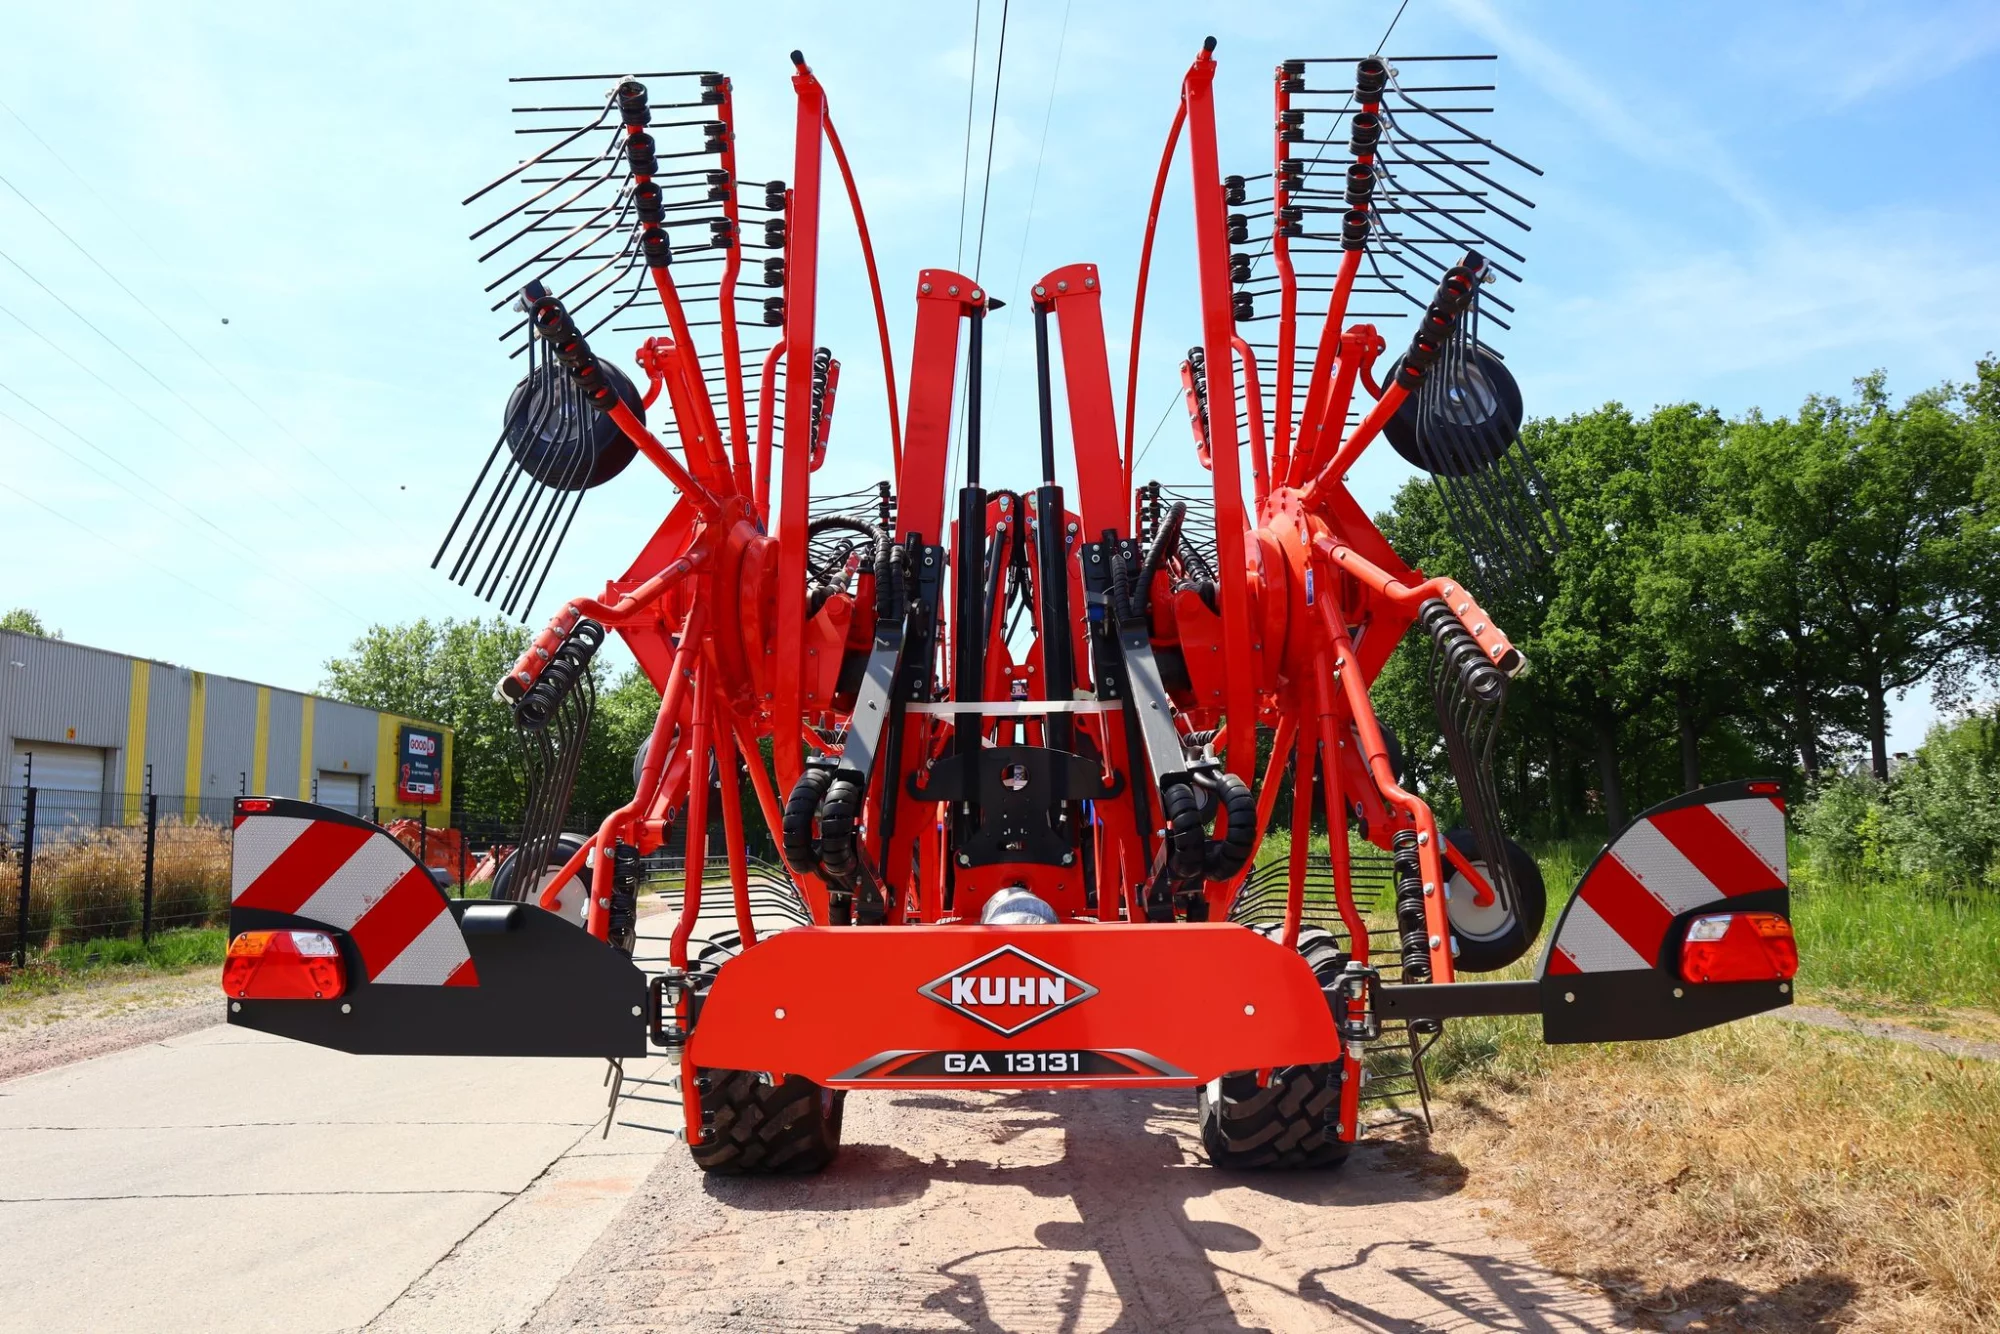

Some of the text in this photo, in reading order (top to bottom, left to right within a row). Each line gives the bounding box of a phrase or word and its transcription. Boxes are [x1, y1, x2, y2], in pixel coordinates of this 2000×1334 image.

[951, 976, 1065, 1005] KUHN
[944, 1053, 1079, 1072] GA 13131
